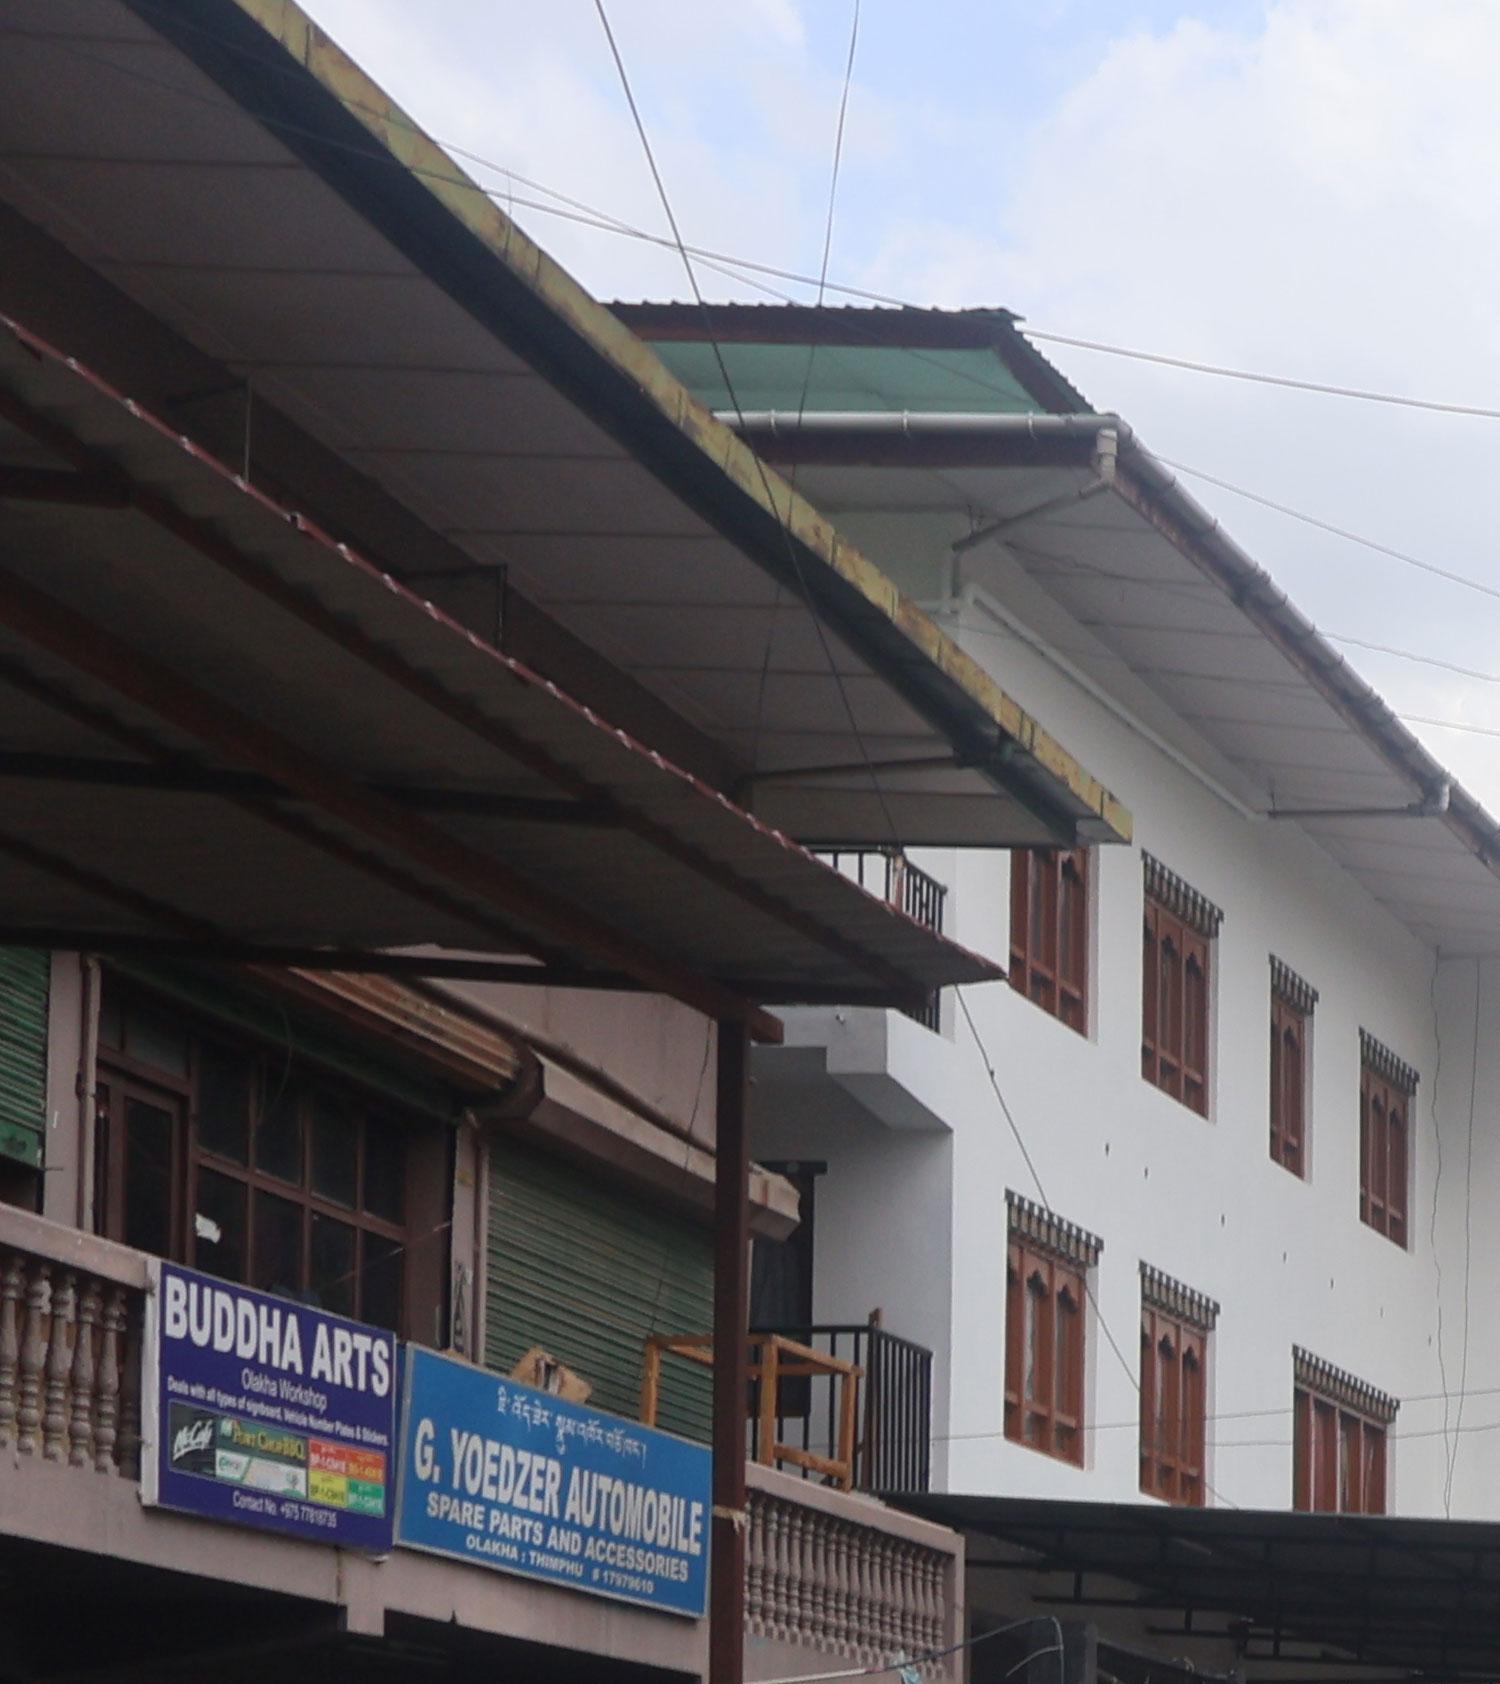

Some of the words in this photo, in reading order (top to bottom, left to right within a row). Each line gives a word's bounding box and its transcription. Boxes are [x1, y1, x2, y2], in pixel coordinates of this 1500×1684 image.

[165, 1274, 303, 1375] BUDDHA
[311, 1322, 390, 1397] ARTS
[241, 1367, 278, 1397] Olakha
[280, 1378, 328, 1413] Workshop
[233, 1489, 263, 1512] Contact
[415, 1418, 440, 1483] G.
[451, 1428, 562, 1519] YOEDZER
[564, 1466, 703, 1557] AUTOMOBILE
[427, 1491, 484, 1531] SPARE
[489, 1506, 543, 1546] PARTS
[547, 1527, 582, 1552] AND
[584, 1536, 689, 1583] ACCESSORIES
[466, 1535, 518, 1561] OLAKHA
[529, 1550, 584, 1578] THIMPHU
